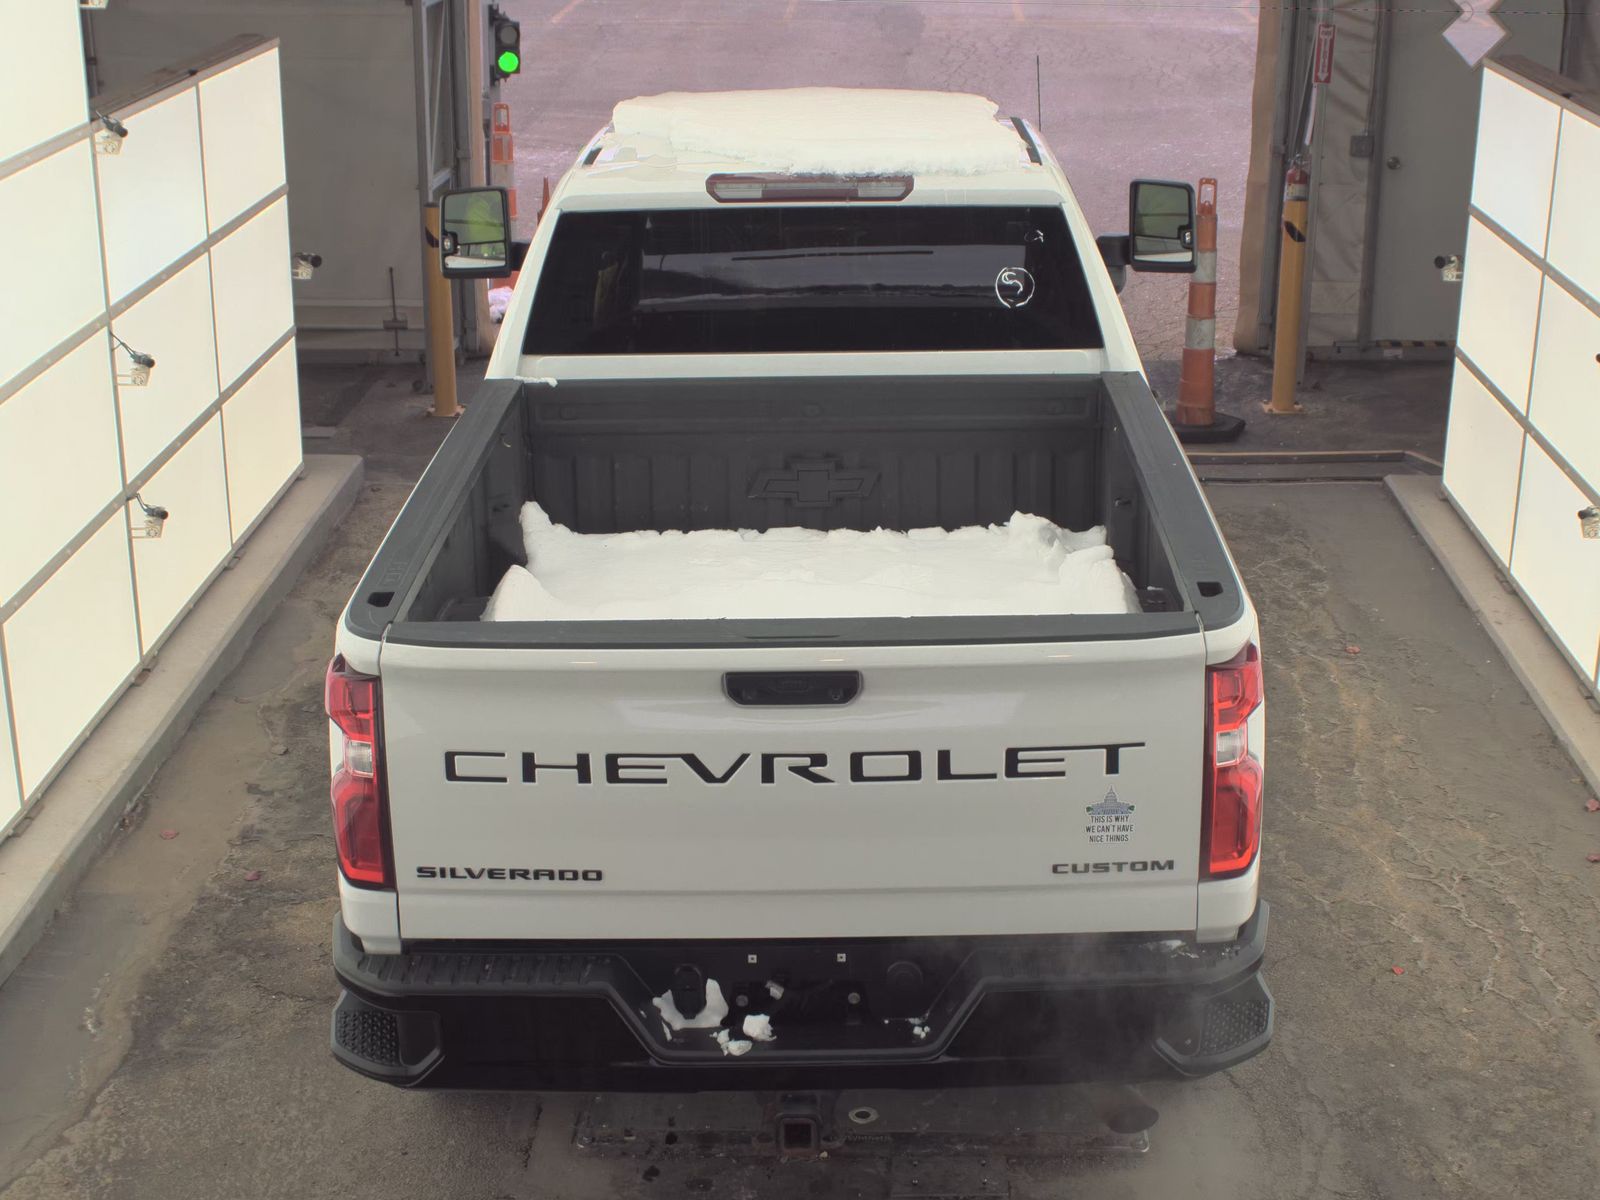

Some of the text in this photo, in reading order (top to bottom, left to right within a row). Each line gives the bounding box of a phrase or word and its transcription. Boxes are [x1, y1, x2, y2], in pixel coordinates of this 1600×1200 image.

[444, 742, 1146, 785] CHEVROLET
[1091, 814, 1129, 823] THIS IS WHY
[1085, 824, 1134, 833] WE CAN'T HAVE
[1089, 834, 1129, 843] NICE THINGS
[1052, 860, 1174, 874] CUSTOM
[416, 866, 603, 882] SILVERADO
